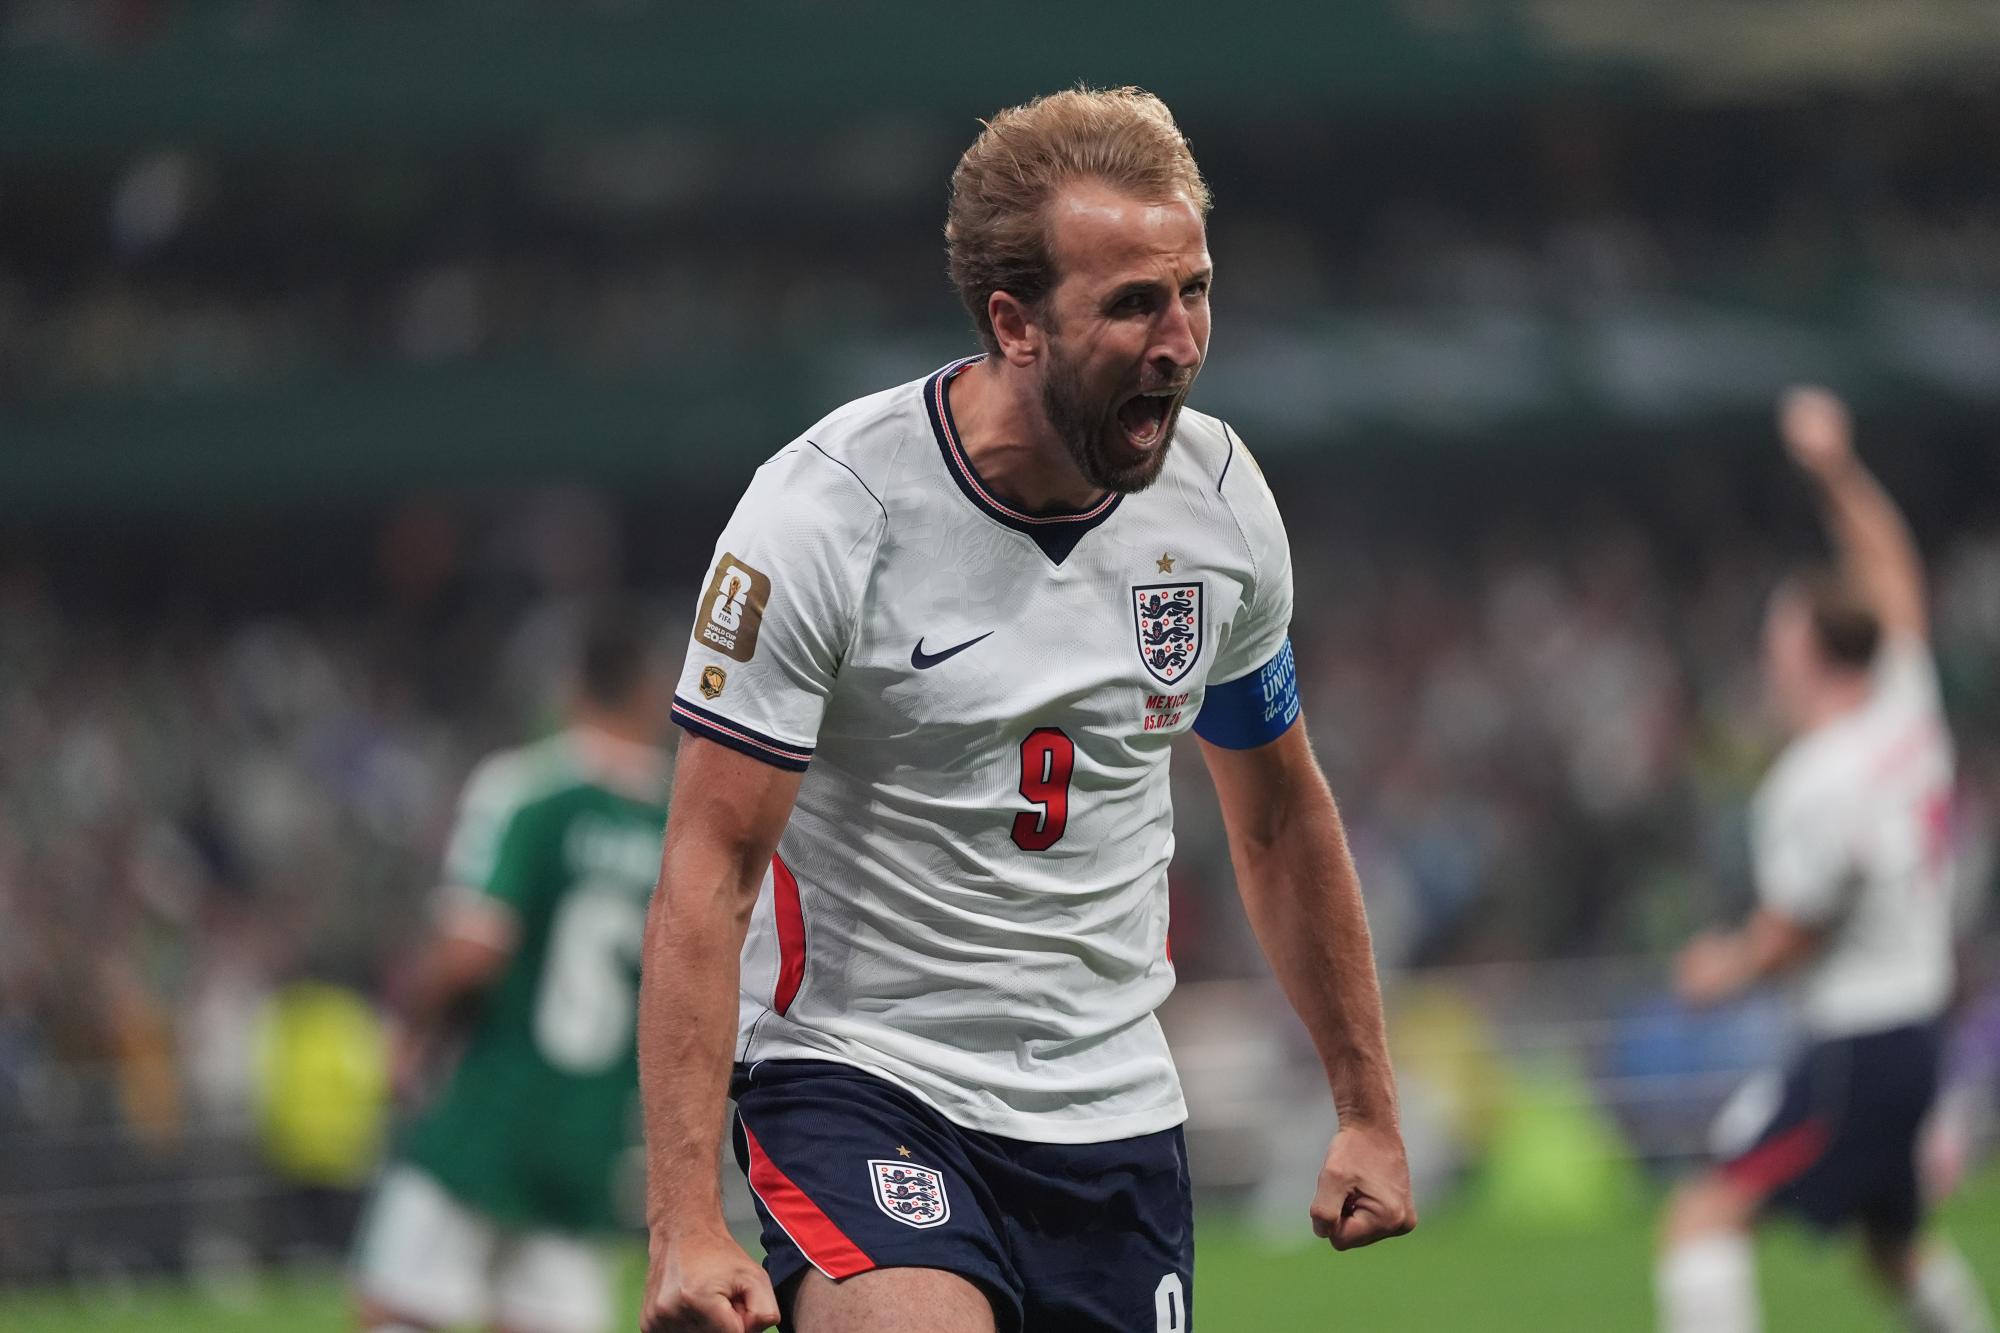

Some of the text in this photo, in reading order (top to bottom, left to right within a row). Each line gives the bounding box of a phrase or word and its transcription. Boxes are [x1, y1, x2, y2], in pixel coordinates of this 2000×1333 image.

[718, 612, 732, 624] FIFA
[703, 628, 735, 650] 2026
[707, 622, 737, 641] WORLD CUP
[1263, 640, 1294, 702] UNITE
[1145, 692, 1189, 709] MEXICO
[1144, 711, 1182, 731] 05.07.26
[1010, 727, 1075, 851] 9
